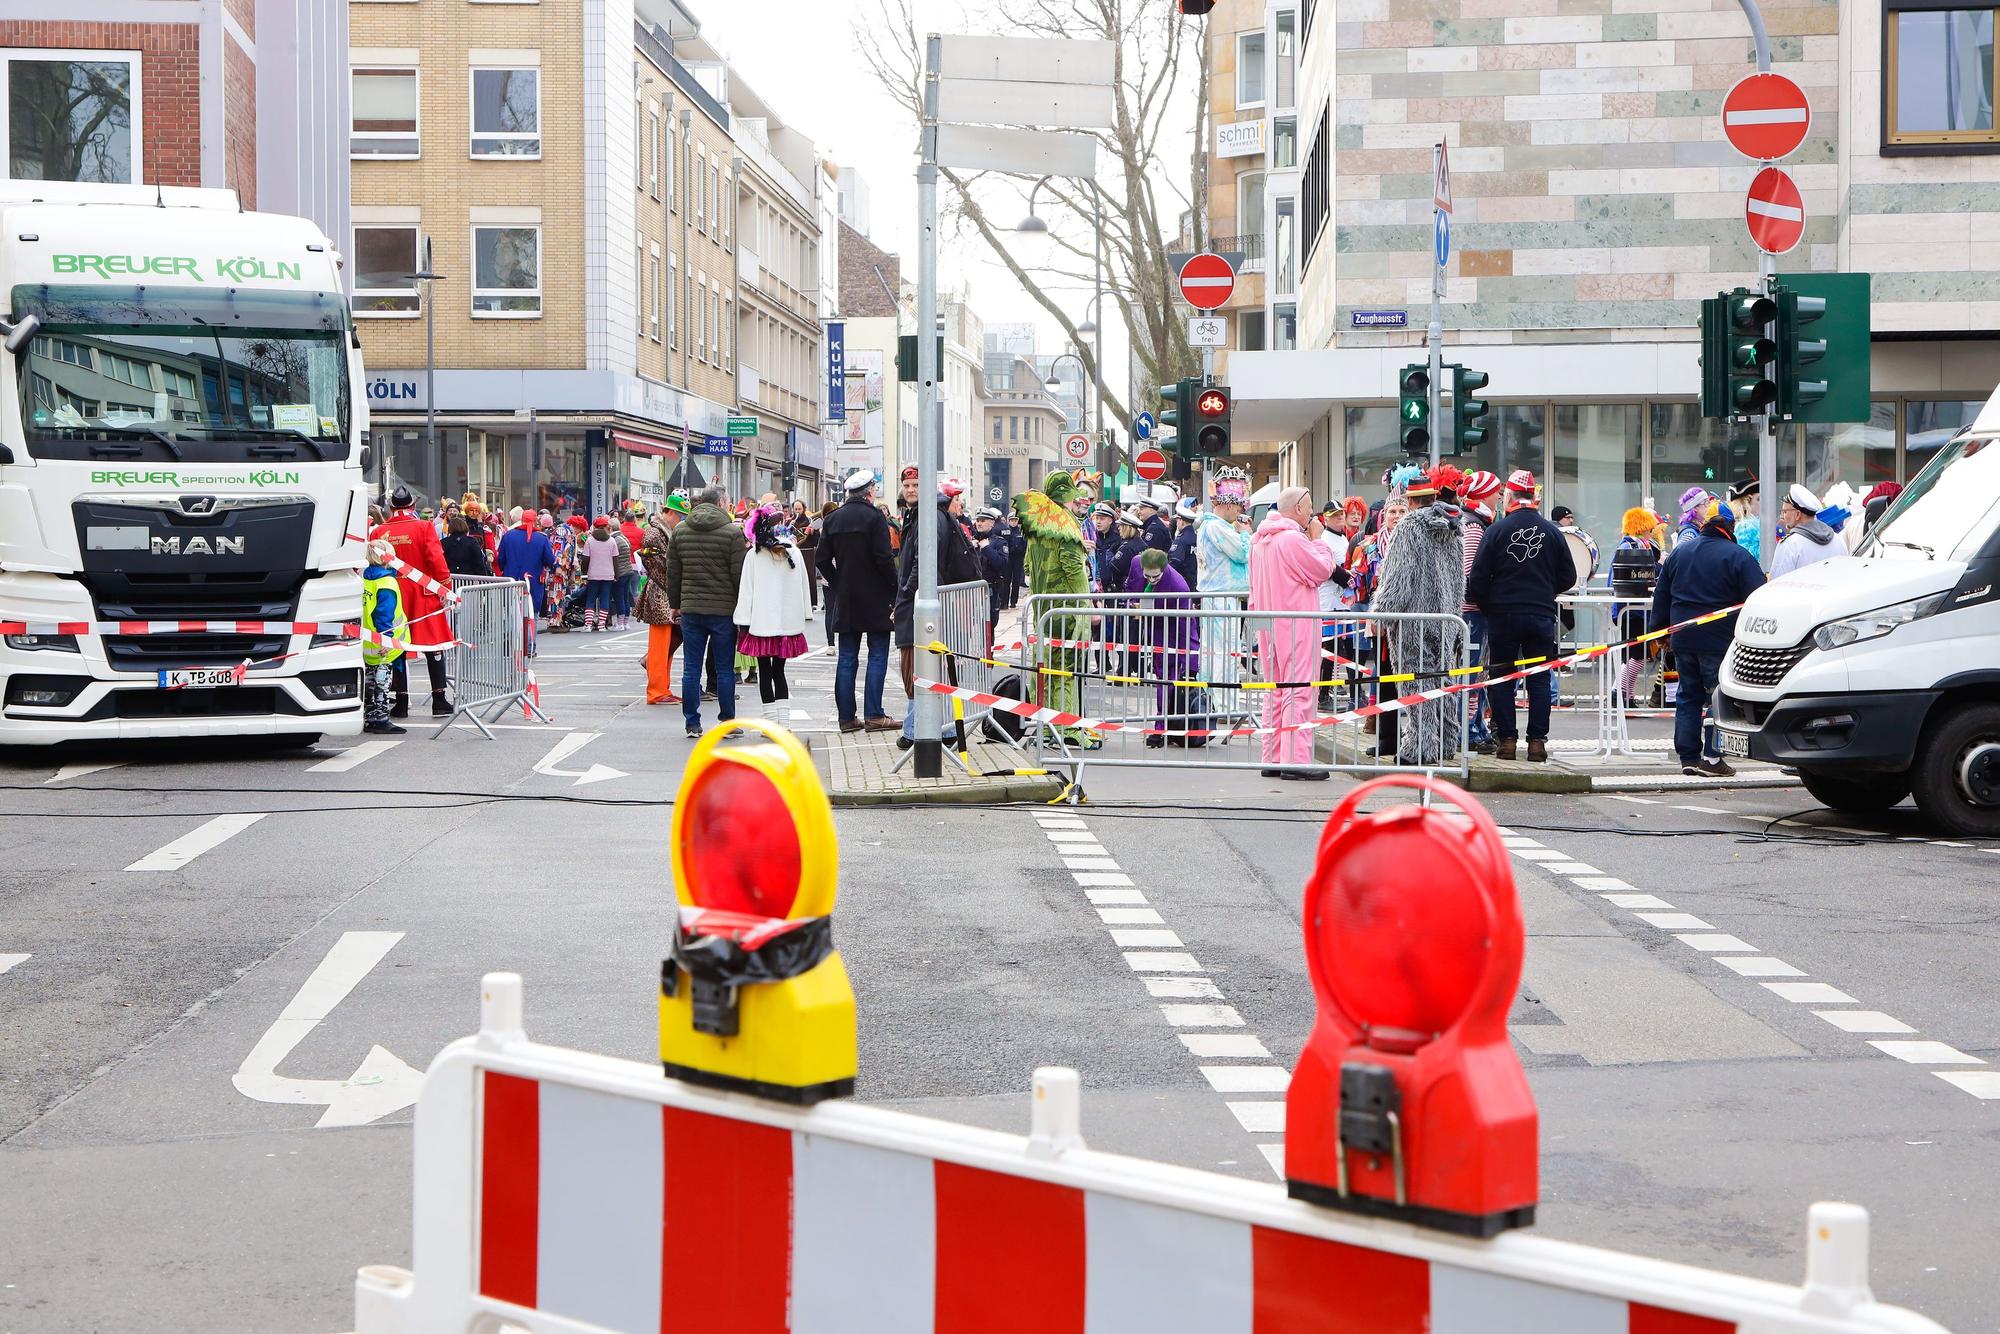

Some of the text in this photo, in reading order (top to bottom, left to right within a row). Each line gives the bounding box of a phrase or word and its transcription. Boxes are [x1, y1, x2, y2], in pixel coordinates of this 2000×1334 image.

[51, 254, 301, 283] BREUER KÖLN
[1355, 313, 1403, 325] Zeughausstr.
[830, 340, 842, 387] KUHN
[90, 469, 300, 488] BREUER SPEDITION KÖLN
[151, 536, 245, 555] MAN
[1744, 616, 1778, 635] IVECO
[171, 672, 180, 685] K
